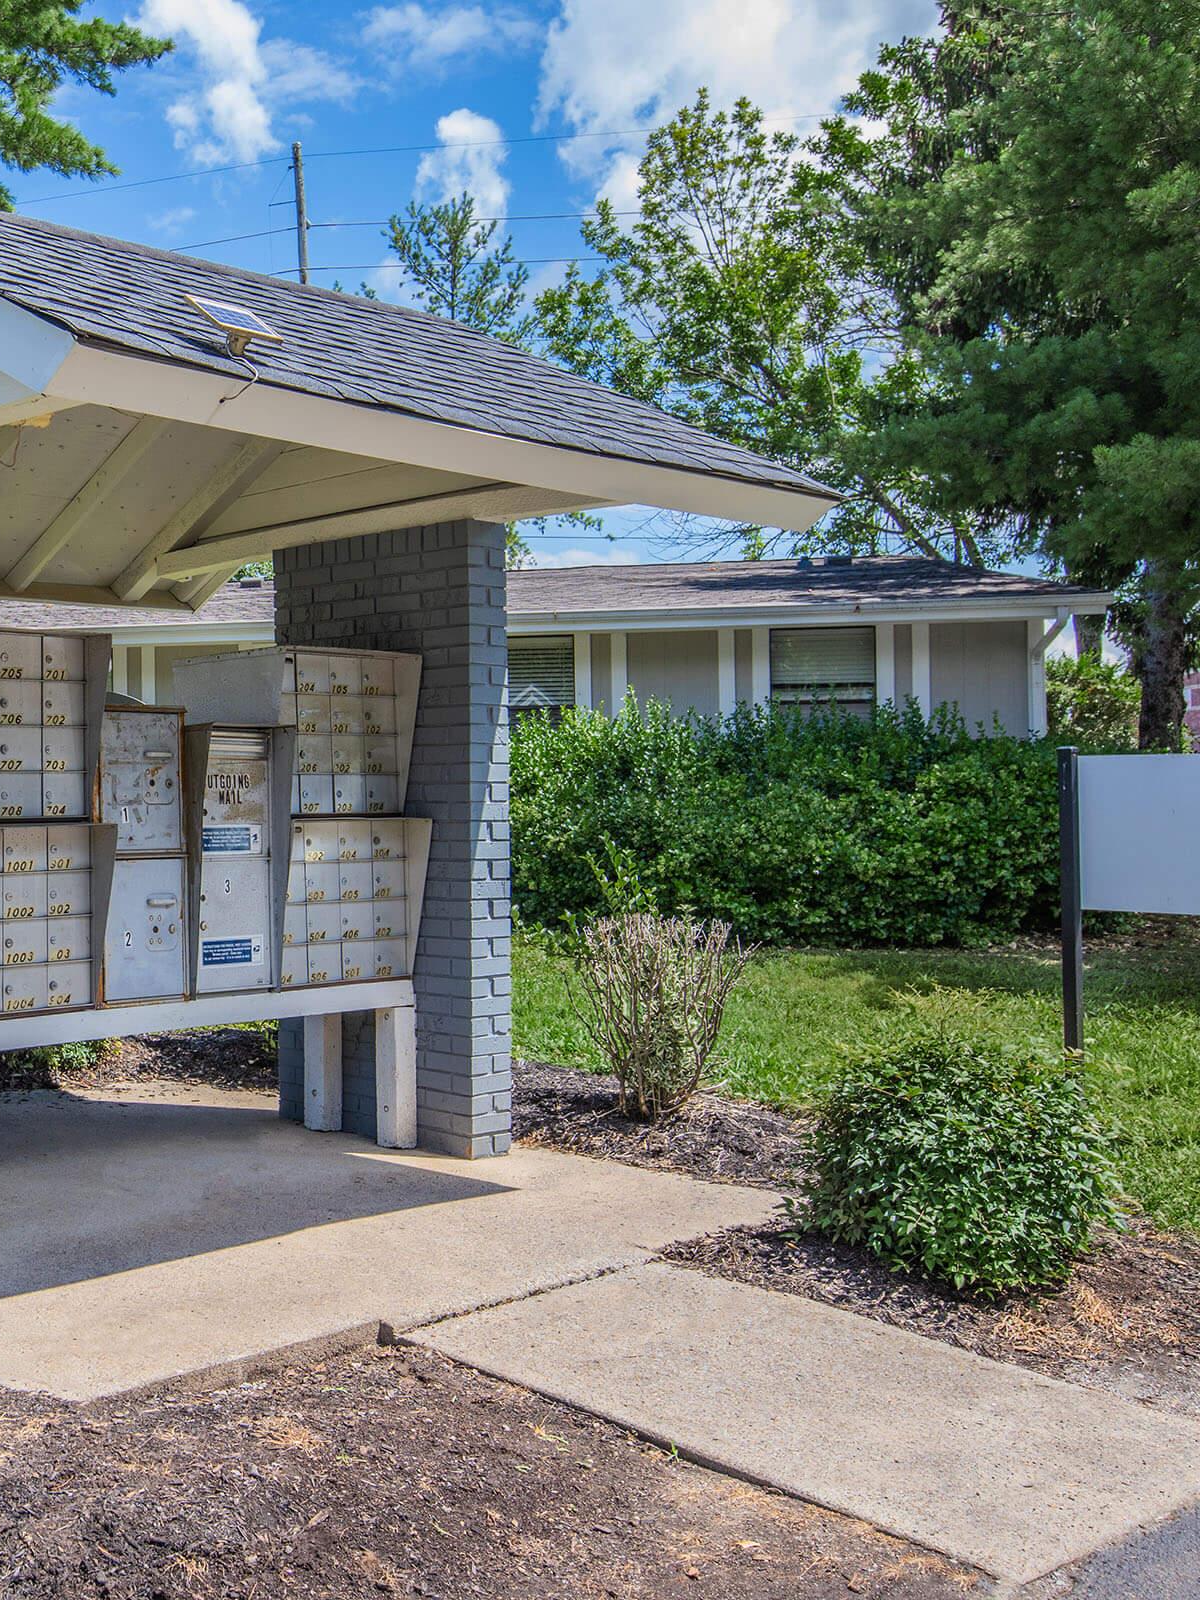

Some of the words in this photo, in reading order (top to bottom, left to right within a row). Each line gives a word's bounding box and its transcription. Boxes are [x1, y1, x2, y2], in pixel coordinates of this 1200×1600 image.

[0, 668, 22, 679] 705
[45, 670, 65, 680] 701
[299, 684, 315, 692] 204
[332, 685, 348, 694] 105
[364, 687, 379, 695] 101
[0, 714, 22, 724] 706
[46, 716, 65, 725] 702
[366, 726, 381, 734] 102
[0, 760, 22, 770] 707
[45, 761, 65, 770] 703
[367, 764, 382, 772] 103
[208, 775, 250, 788] UTGOING
[219, 790, 242, 804] MAIL
[1, 806, 22, 816] 708
[369, 803, 384, 811] 104
[123, 808, 128, 822] 1
[341, 851, 357, 860] 404
[7, 861, 33, 872] 1001
[224, 880, 231, 894] 3
[342, 890, 359, 899] 405
[375, 888, 391, 897] 401
[7, 907, 34, 917] 1002
[50, 904, 71, 914] 902
[125, 932, 132, 946] 2
[310, 931, 326, 941] 504
[343, 930, 359, 939] 406
[7, 952, 34, 963] 1003
[345, 968, 360, 978] 501
[7, 998, 35, 1009] 1004
